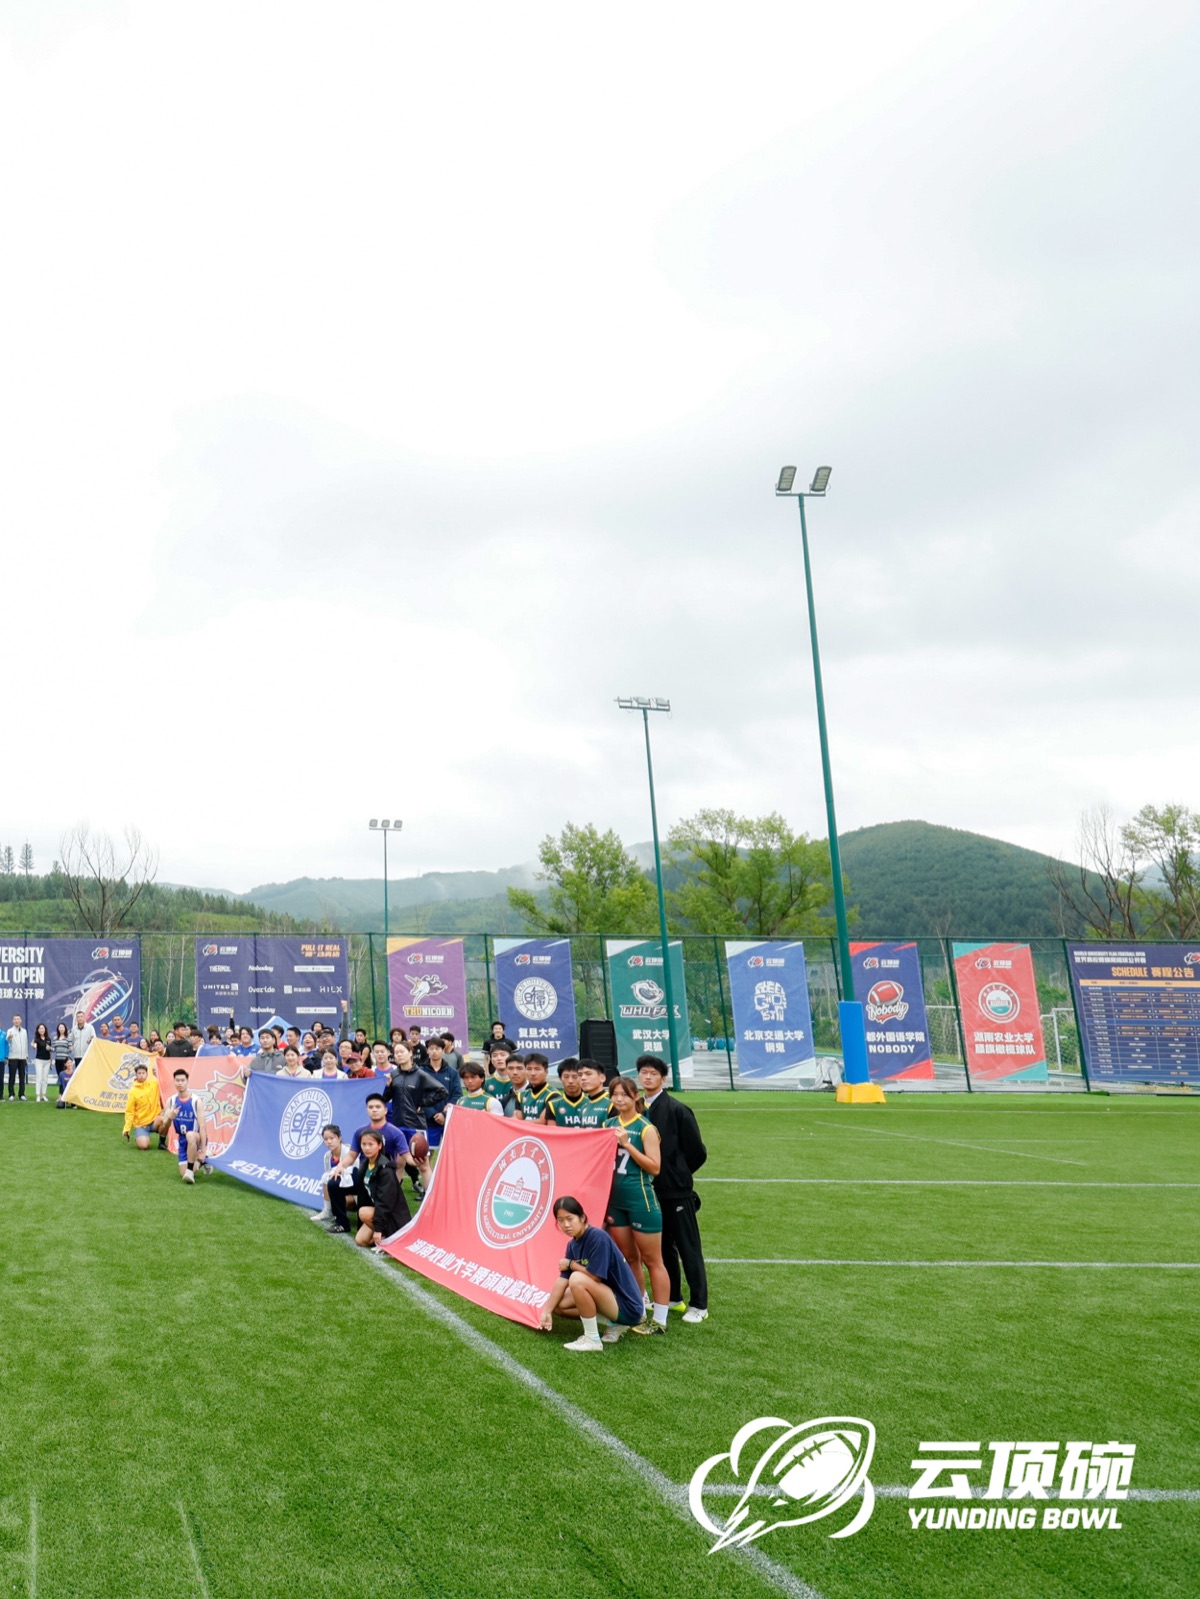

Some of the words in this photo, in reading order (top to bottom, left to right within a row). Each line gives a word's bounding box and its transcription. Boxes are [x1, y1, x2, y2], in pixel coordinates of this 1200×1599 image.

[13, 966, 45, 984] OPEN
[1111, 967, 1148, 977] SCHEDULE
[405, 1006, 452, 1016] THUNICORN
[518, 1028, 558, 1038] 复旦大学
[632, 1029, 670, 1040] 武汉大学
[744, 1030, 804, 1041] 北京交通大学
[866, 1031, 925, 1042] 都外国语学院
[974, 1031, 1034, 1043] 湖南农业大学
[517, 1040, 561, 1049] HORNET
[868, 1044, 915, 1053] NOBODY
[84, 1096, 110, 1108] GOLDEN
[228, 1160, 280, 1181] 复旦大学
[278, 1172, 325, 1196] HORNE
